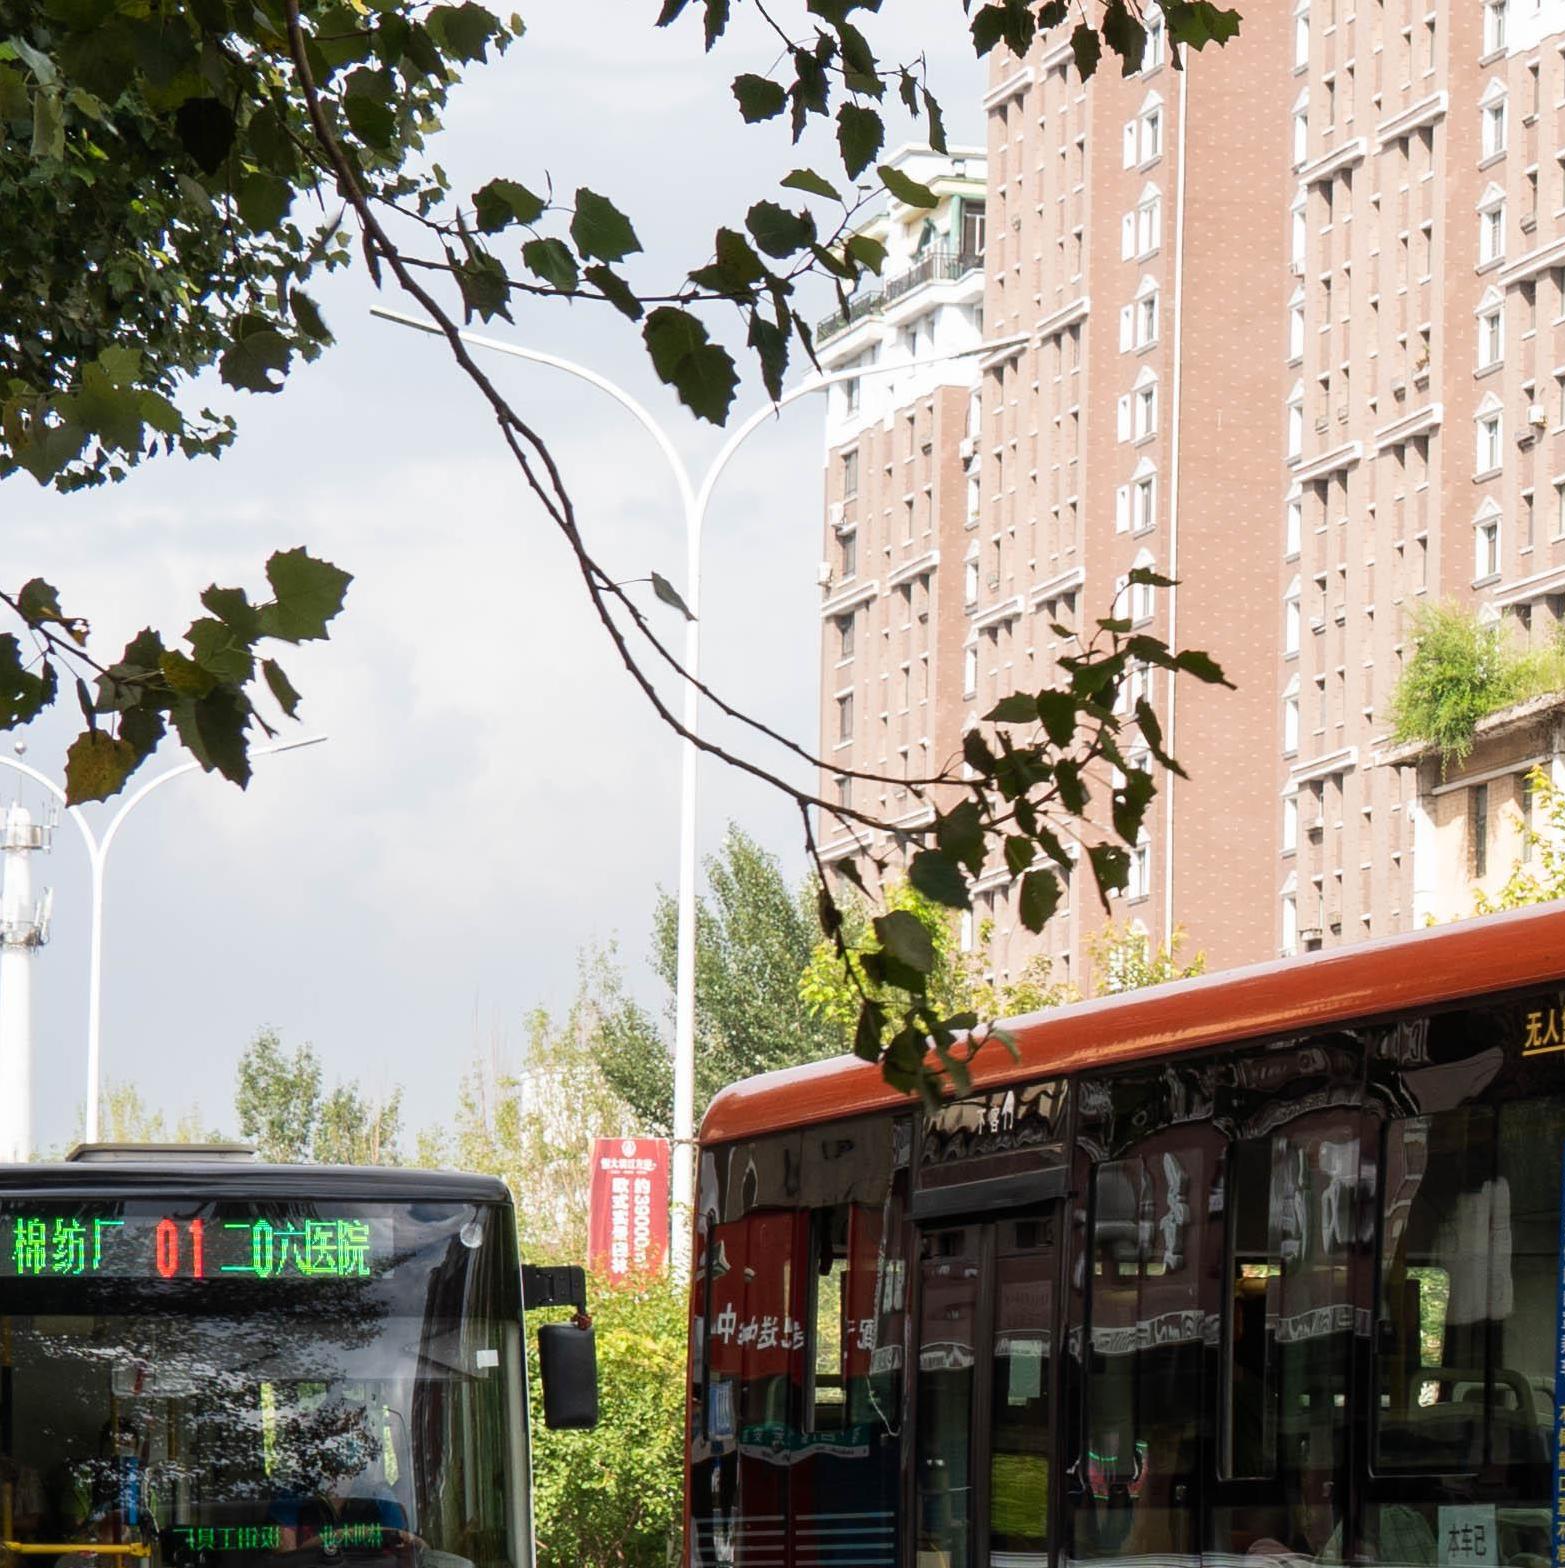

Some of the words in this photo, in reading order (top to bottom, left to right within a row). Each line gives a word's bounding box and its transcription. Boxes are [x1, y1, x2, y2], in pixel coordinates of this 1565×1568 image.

[13, 1218, 124, 1274] 棉纺厂
[156, 1218, 205, 1278] 01
[1448, 1523, 1487, 1557] 本车已
